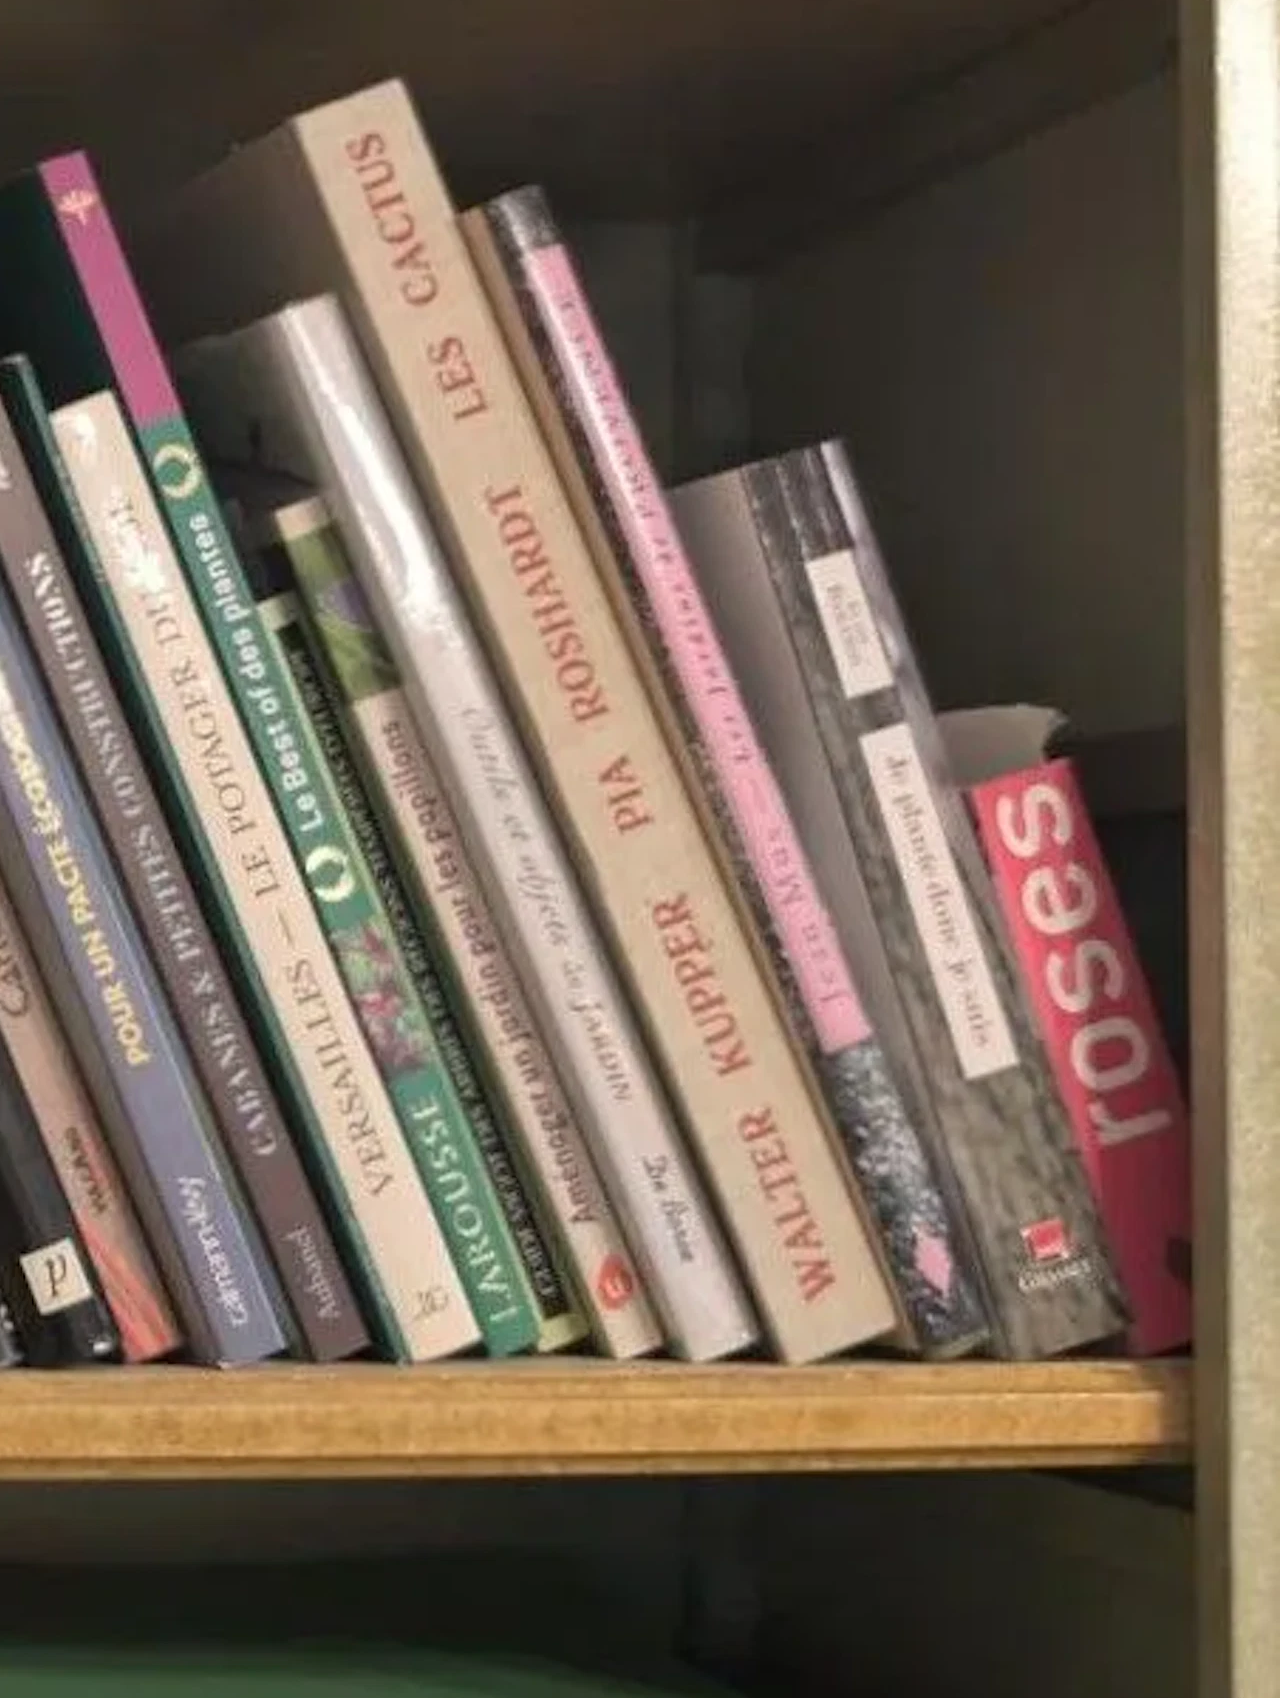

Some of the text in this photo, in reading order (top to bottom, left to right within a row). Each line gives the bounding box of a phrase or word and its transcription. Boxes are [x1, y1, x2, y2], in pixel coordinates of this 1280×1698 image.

[344, 129, 439, 308] CACTUS
[429, 334, 493, 422] LES
[484, 481, 609, 724] ROSHARDT
[598, 754, 654, 835] PIA
[187, 511, 525, 1323] LAROUSSE Le Best of des plantes
[651, 893, 751, 1077] KUPPER
[995, 782, 1172, 1146] roses
[738, 1105, 838, 1302] WALTER
